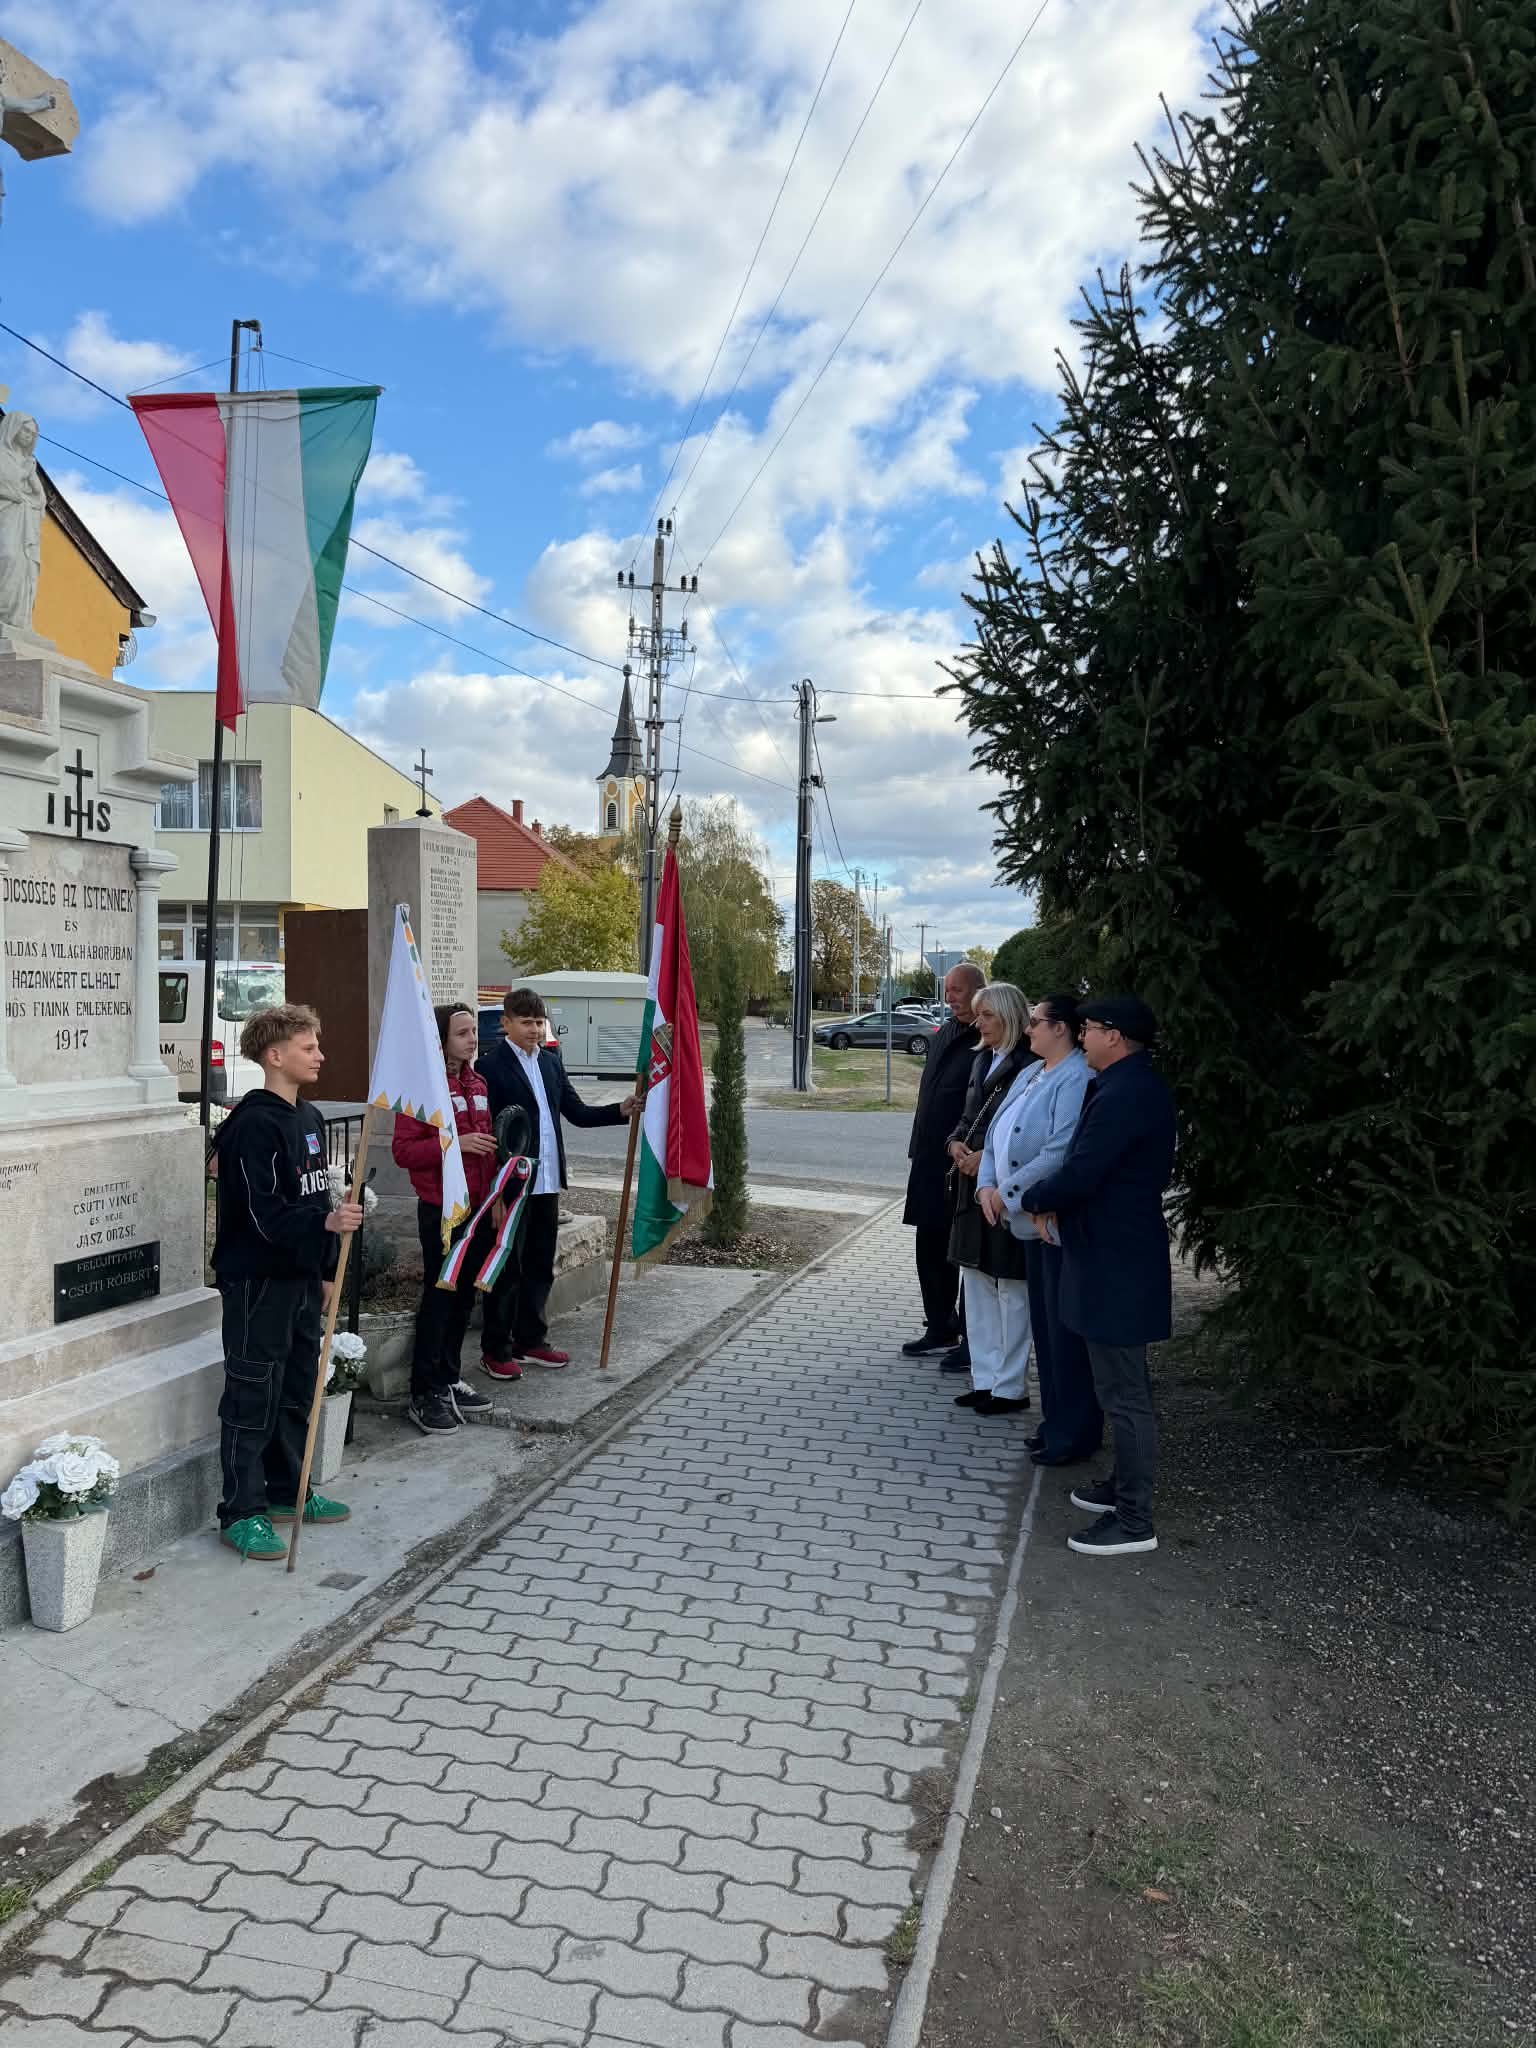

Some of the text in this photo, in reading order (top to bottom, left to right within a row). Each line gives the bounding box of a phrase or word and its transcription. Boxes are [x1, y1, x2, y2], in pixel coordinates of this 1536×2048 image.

[47, 792, 111, 833] IHS
[63, 883, 77, 908] AZ
[83, 885, 133, 912] ISTENNEK
[41, 942, 47, 957] A
[80, 972, 120, 989] ELHALT
[56, 1028, 89, 1050] 1917
[68, 1279, 104, 1298] CSUTI
